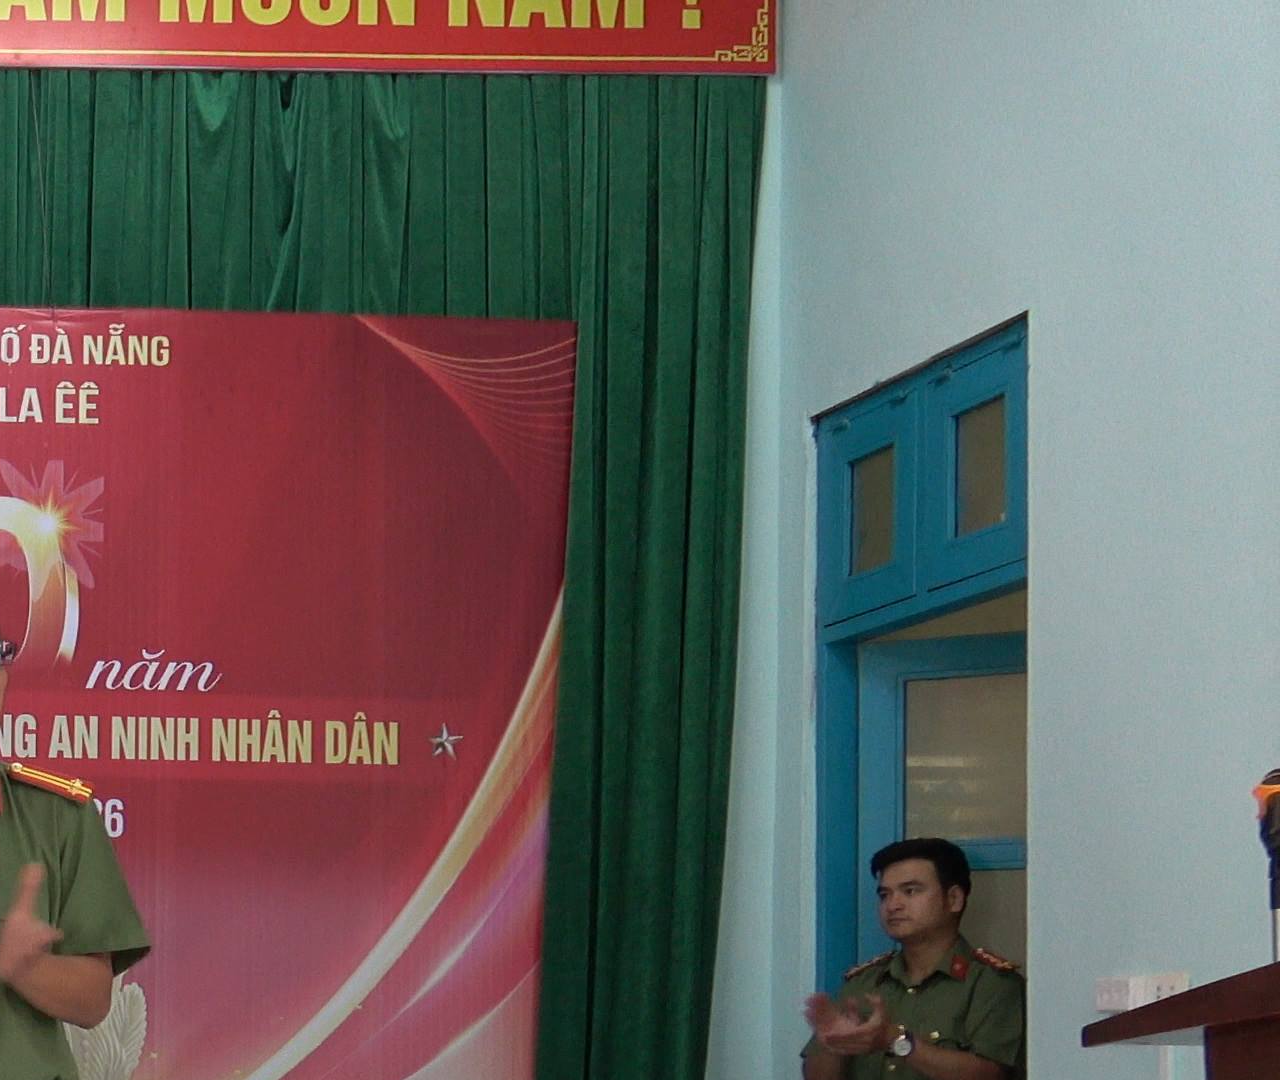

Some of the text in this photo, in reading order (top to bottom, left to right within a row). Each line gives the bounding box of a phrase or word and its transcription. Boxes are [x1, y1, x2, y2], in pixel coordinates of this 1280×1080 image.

[29, 327, 73, 365] ĐÀ
[83, 323, 170, 366] NẴNG
[55, 381, 100, 424] ÊÊ
[84, 649, 222, 691] năm
[48, 715, 99, 759] AN
[110, 716, 199, 761] NINH
[211, 709, 313, 763] NHÂN
[324, 711, 400, 765] DÂN
